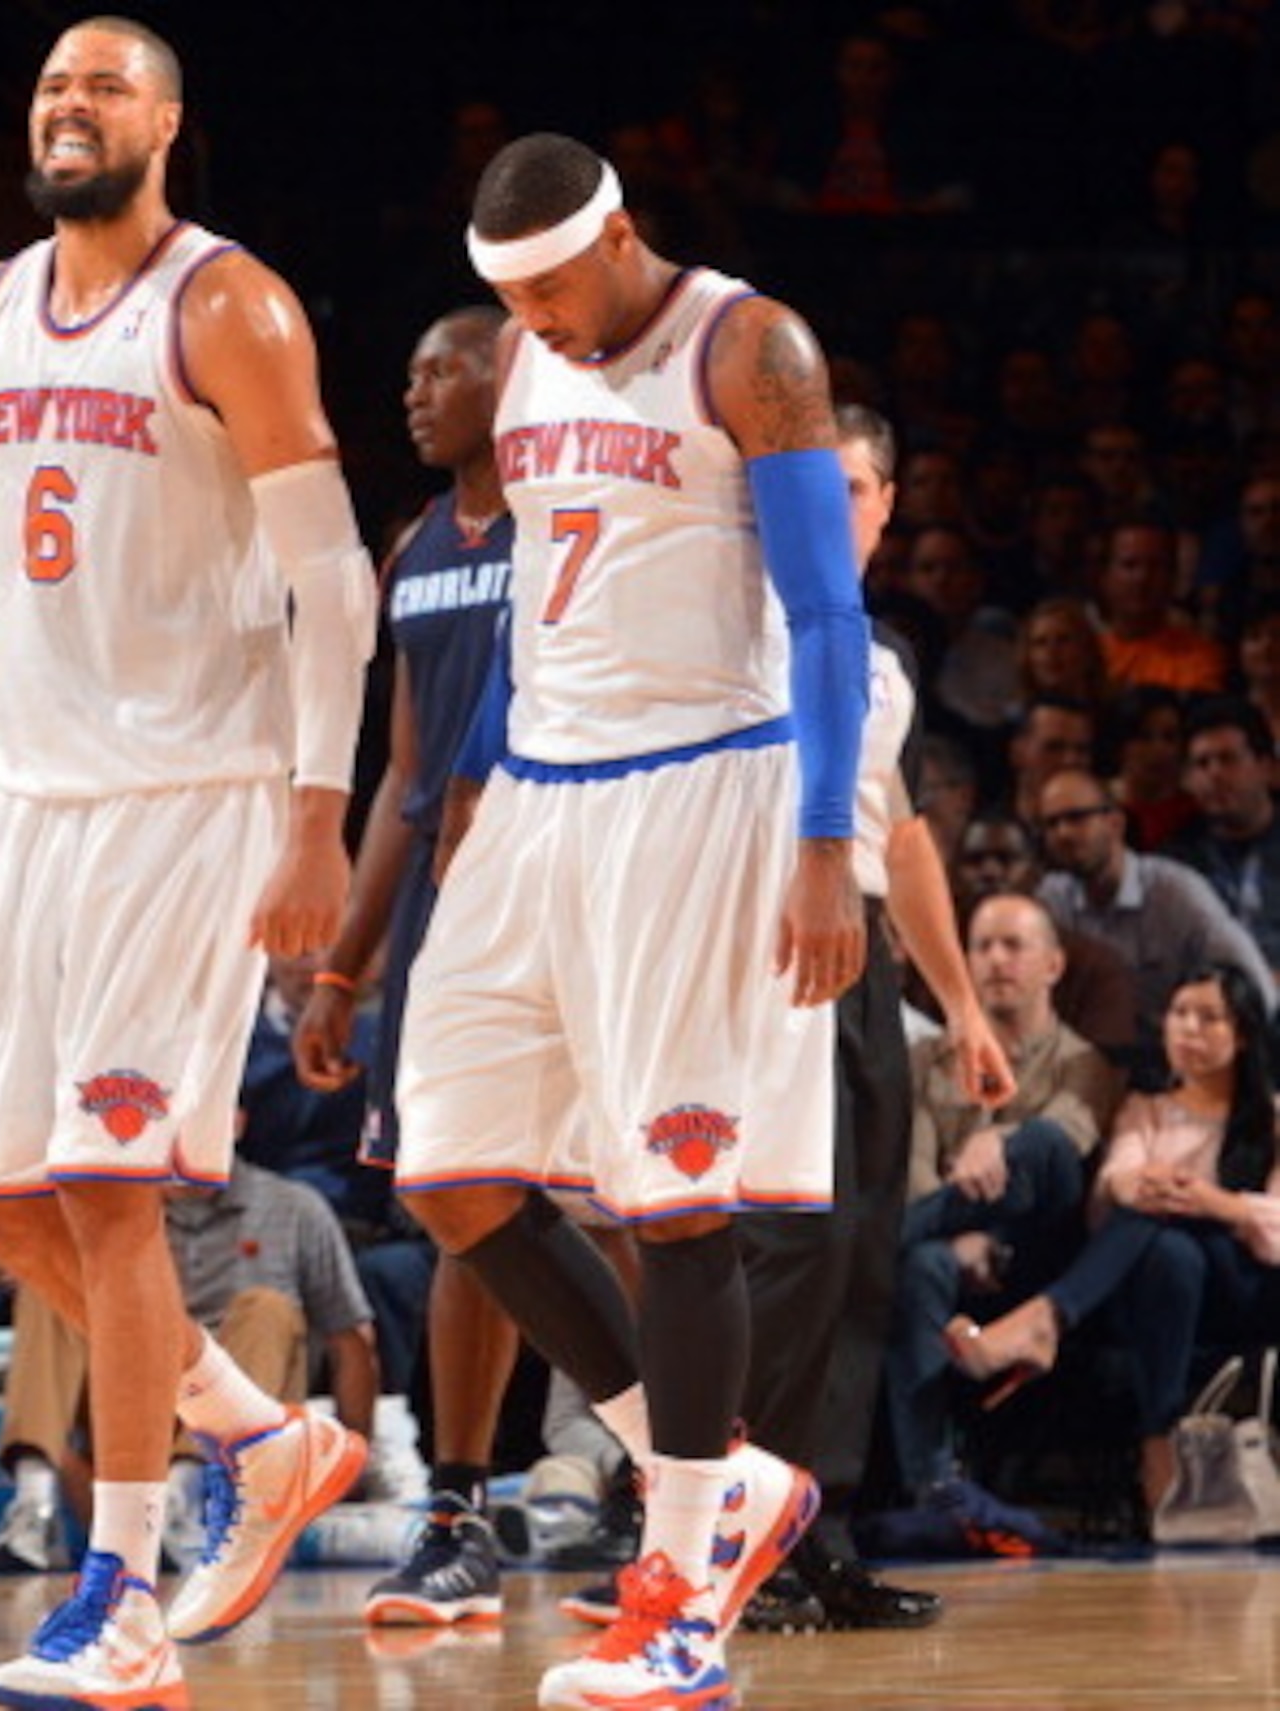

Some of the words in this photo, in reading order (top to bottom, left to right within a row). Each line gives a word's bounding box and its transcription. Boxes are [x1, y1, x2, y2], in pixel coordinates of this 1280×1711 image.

[48, 386, 158, 455] YORK
[498, 420, 569, 483] NEW
[573, 418, 682, 489] YORK
[25, 465, 78, 582] 6
[390, 561, 514, 622] CHARLOT
[541, 507, 602, 624] 7
